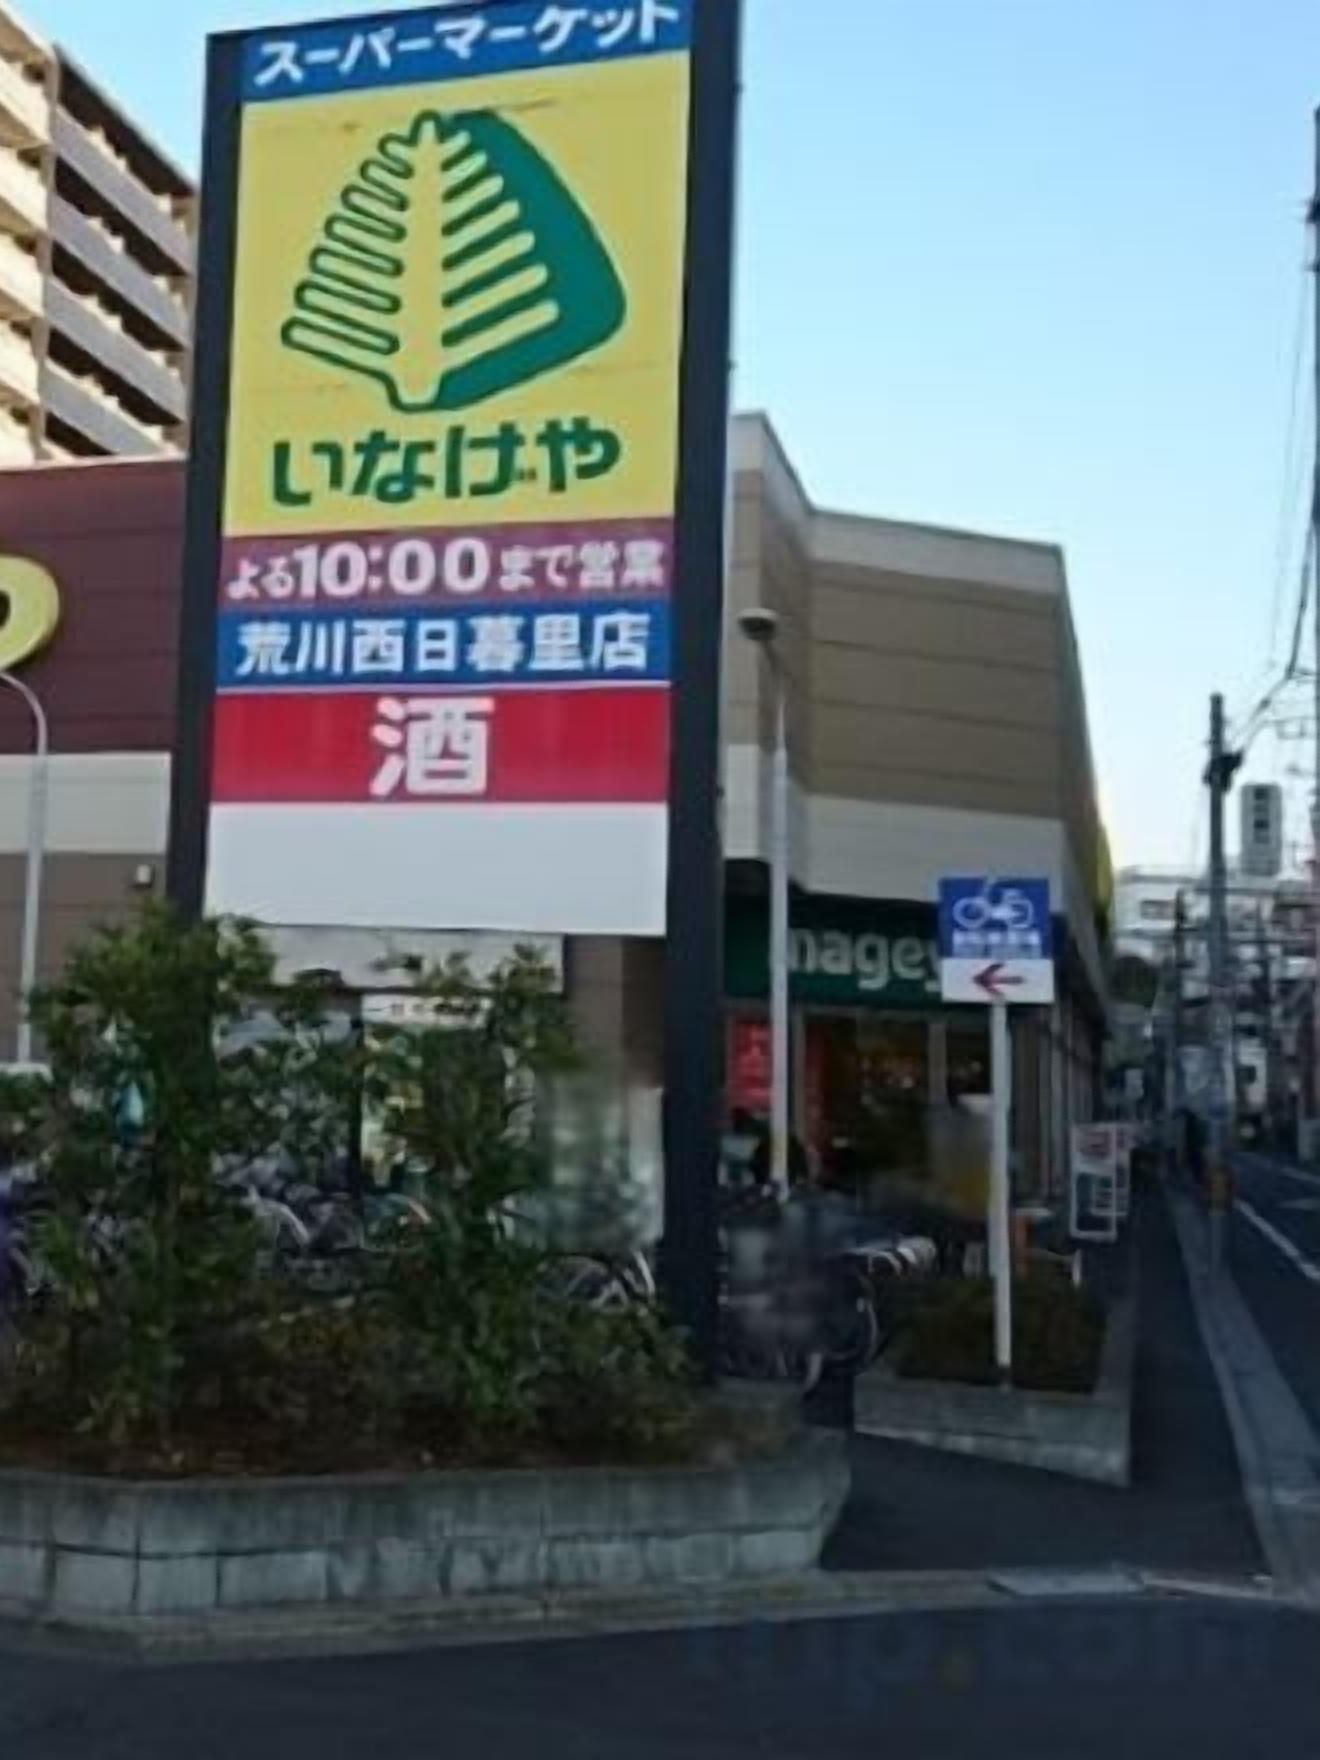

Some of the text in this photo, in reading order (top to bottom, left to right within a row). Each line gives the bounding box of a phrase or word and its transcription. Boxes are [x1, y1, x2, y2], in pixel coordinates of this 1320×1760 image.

[253, 0, 680, 88] スーパーマーケット
[273, 416, 622, 506] いなげや
[236, 611, 651, 675] 荒川西日暮里店
[369, 696, 495, 798] 酒
